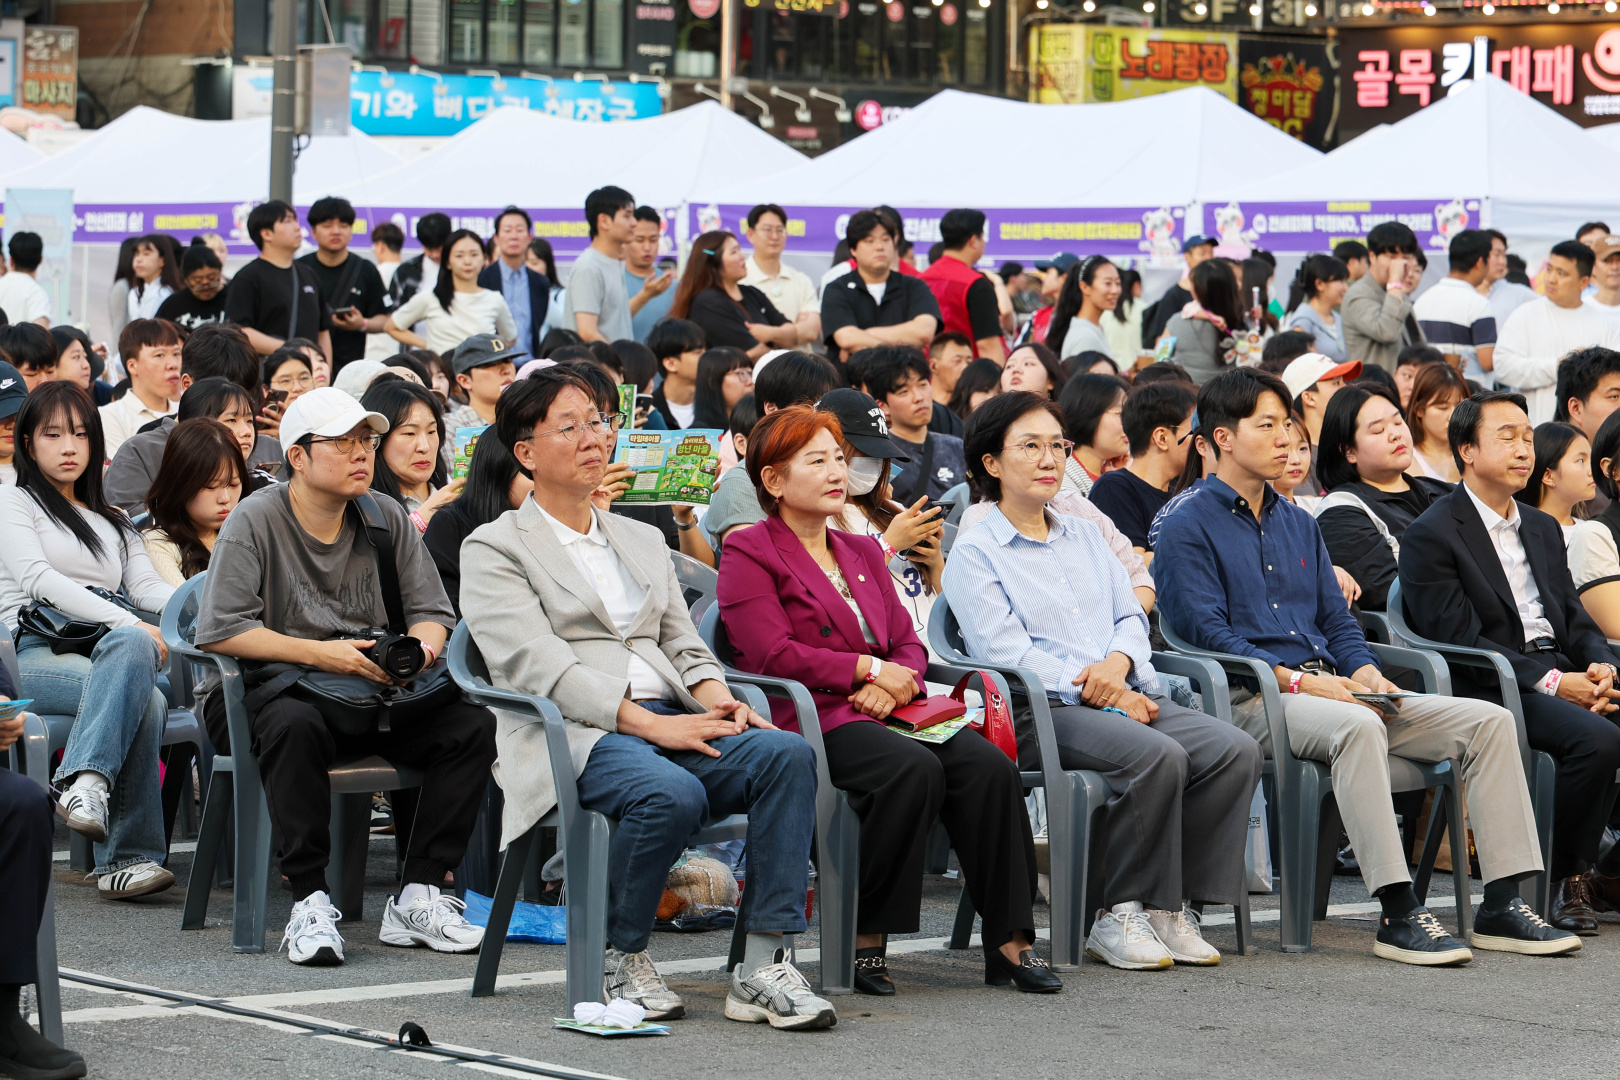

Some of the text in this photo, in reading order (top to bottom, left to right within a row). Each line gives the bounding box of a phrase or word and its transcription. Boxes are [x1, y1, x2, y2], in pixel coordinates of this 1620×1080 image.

[1119, 37, 1229, 83] 노래광장
[1353, 35, 1575, 108] 골목킹대패
[24, 78, 76, 107] 마사지
[490, 338, 506, 353] D
